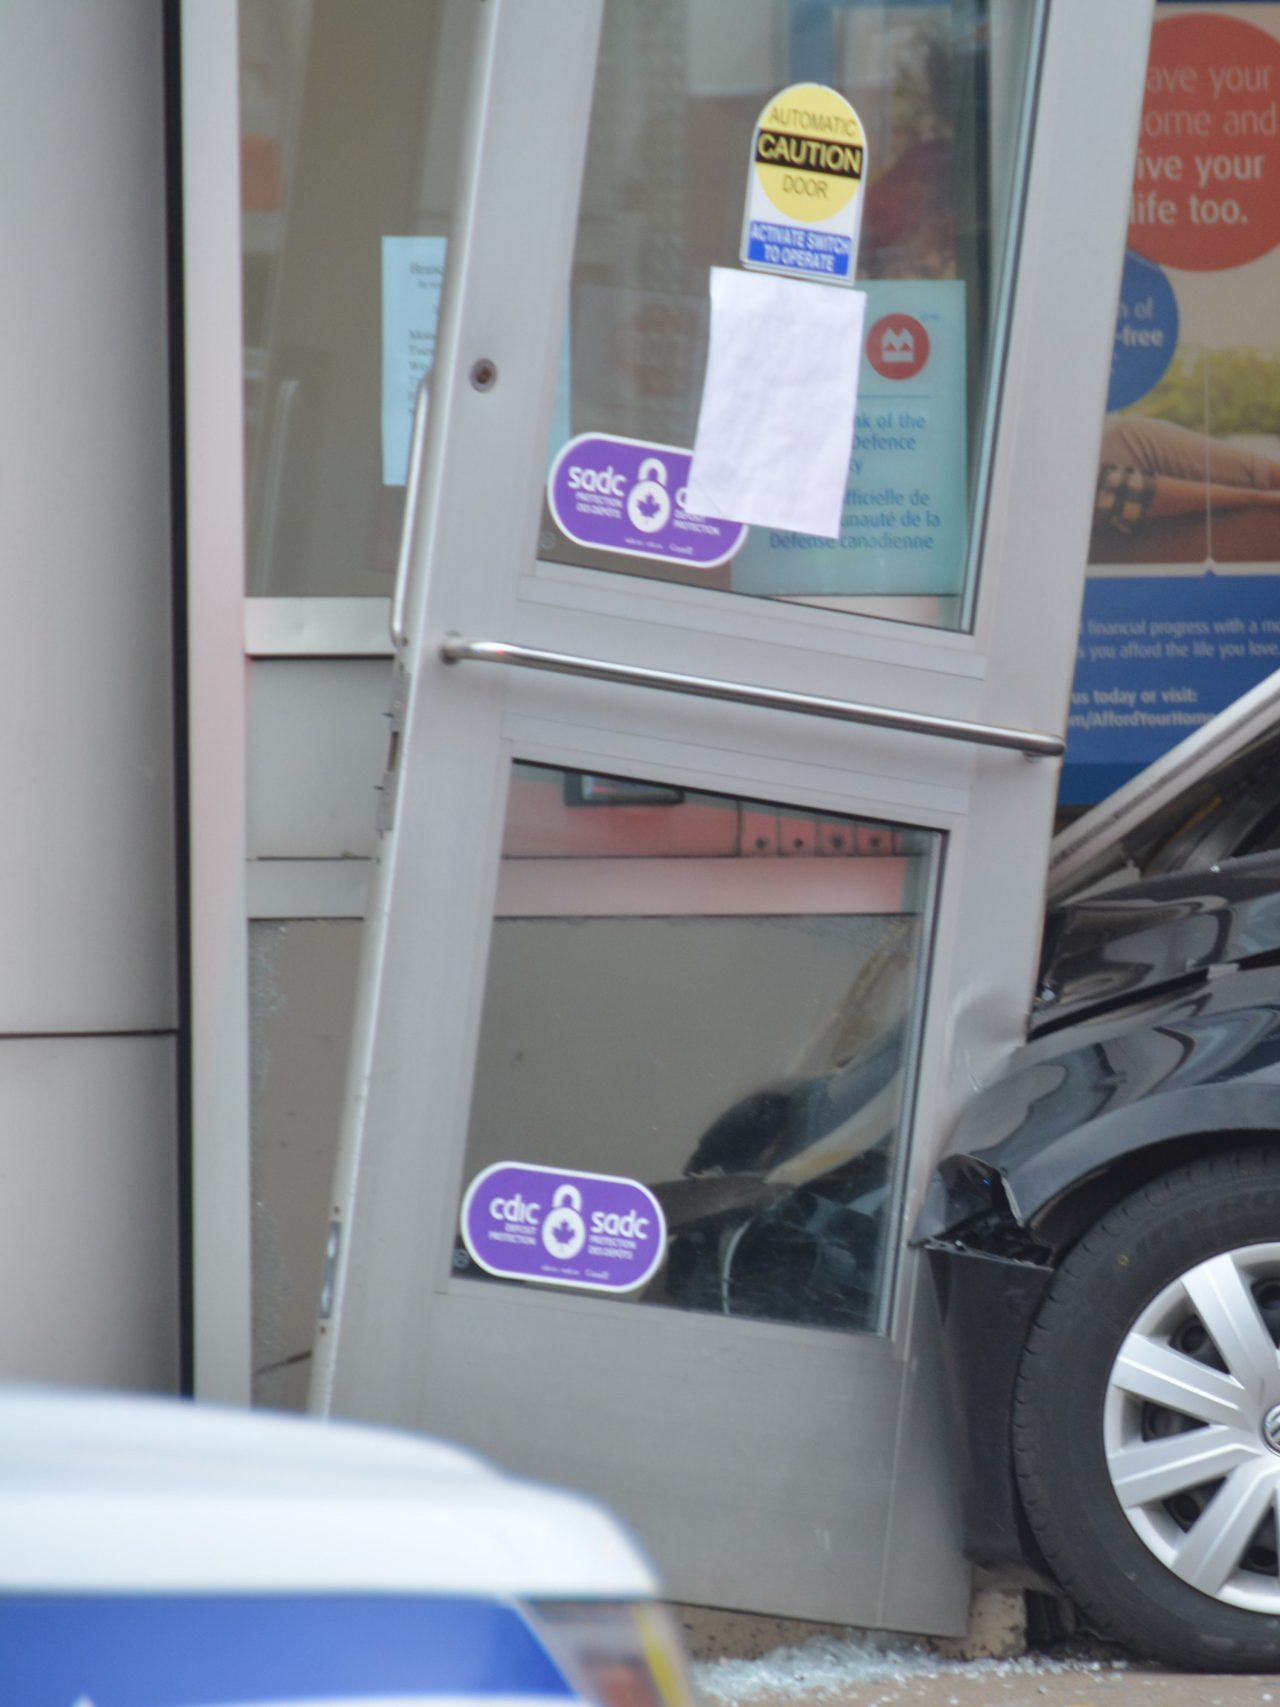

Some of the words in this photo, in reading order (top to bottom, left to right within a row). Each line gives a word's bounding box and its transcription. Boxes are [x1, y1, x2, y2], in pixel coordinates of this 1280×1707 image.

[1145, 65, 1197, 94] ave
[1208, 64, 1273, 99] your
[770, 107, 856, 136] AUTOMATIC
[1142, 110, 1212, 138] ome
[1223, 102, 1278, 137] and
[758, 134, 861, 174] CAUTION
[1137, 154, 1184, 182] ive
[1196, 154, 1264, 188] your
[783, 175, 828, 199] DOOR
[1188, 196, 1248, 225] too.
[751, 222, 806, 248] ACTIVATE
[808, 231, 850, 255] SWITCH
[764, 244, 782, 262] TO
[783, 247, 836, 271] OPERATE
[876, 413, 893, 430] of
[898, 412, 926, 430] the
[567, 465, 627, 497] sadc
[845, 489, 904, 506] fficielle
[910, 489, 930, 506] de
[901, 511, 922, 528] de
[926, 511, 941, 528] la
[1088, 619, 1146, 636] financial
[1150, 620, 1209, 638] progress
[1093, 687, 1137, 708] today
[1140, 691, 1157, 704] or
[591, 1209, 649, 1240] sadc
